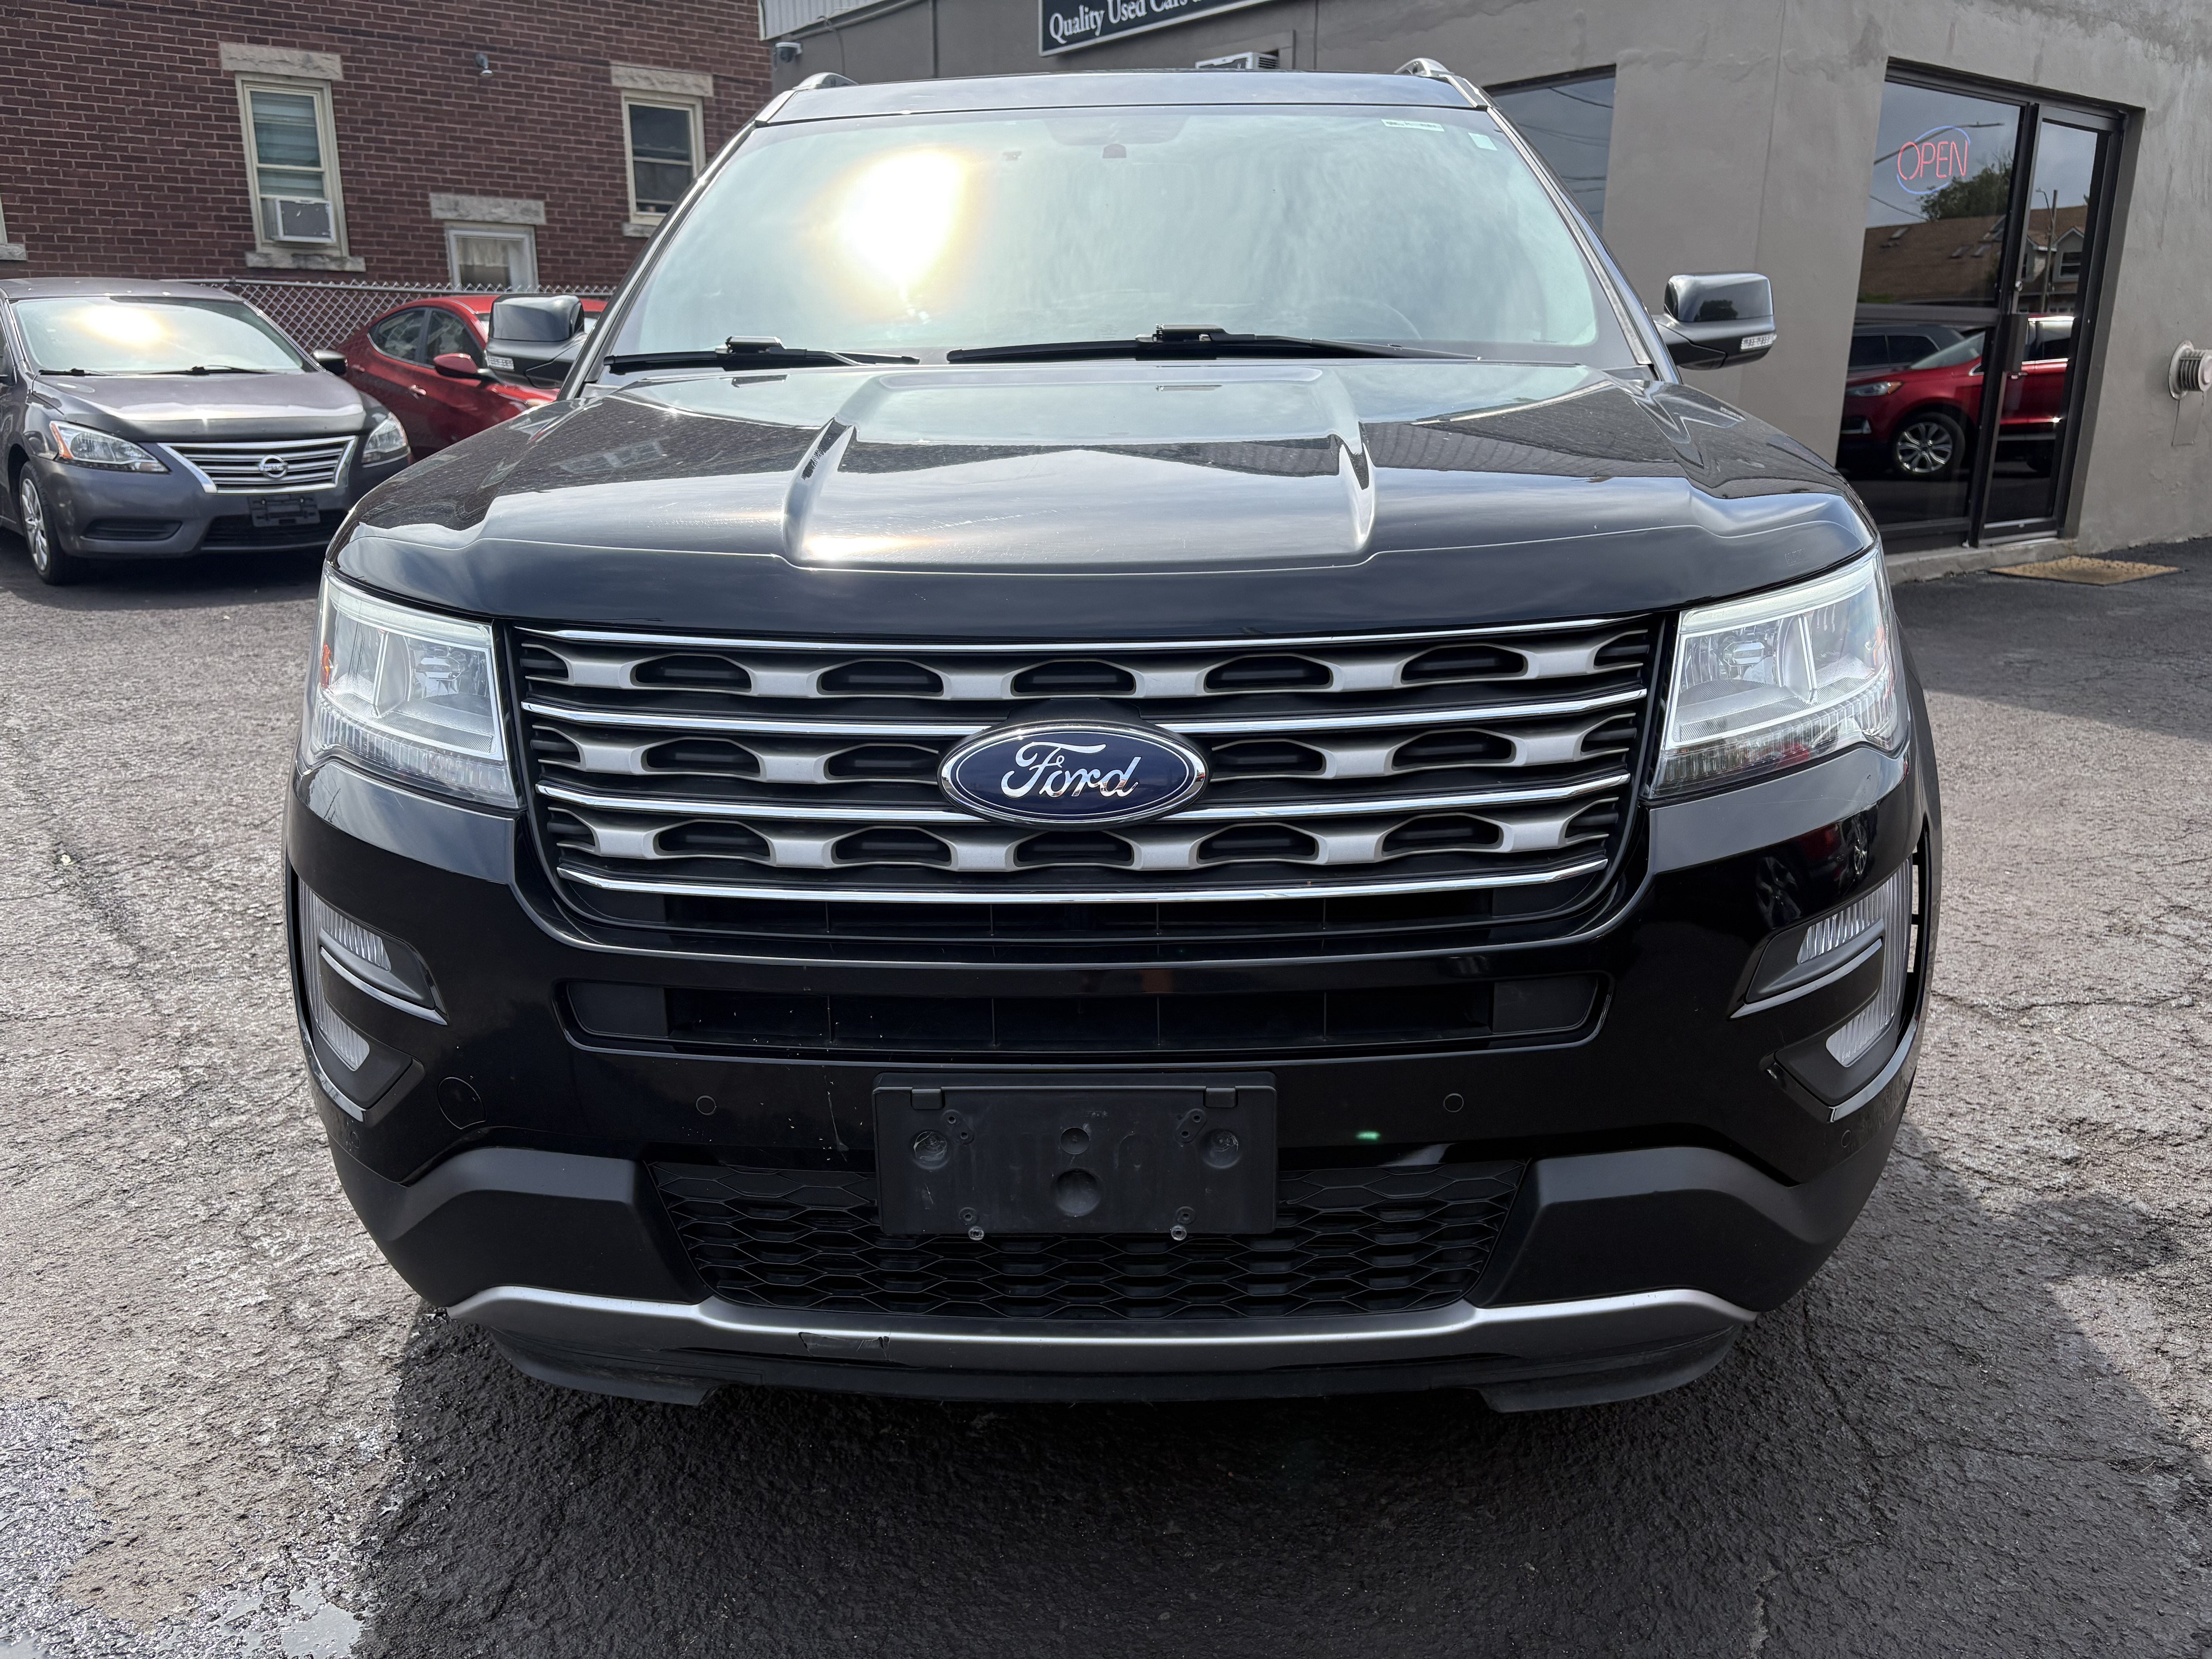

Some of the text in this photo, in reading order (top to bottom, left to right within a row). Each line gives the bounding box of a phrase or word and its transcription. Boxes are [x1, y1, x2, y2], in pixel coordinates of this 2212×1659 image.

[1049, 0, 1188, 44] Quality Used Ca
[1898, 139, 1968, 180] OPEN
[1001, 741, 1142, 798] Ford
